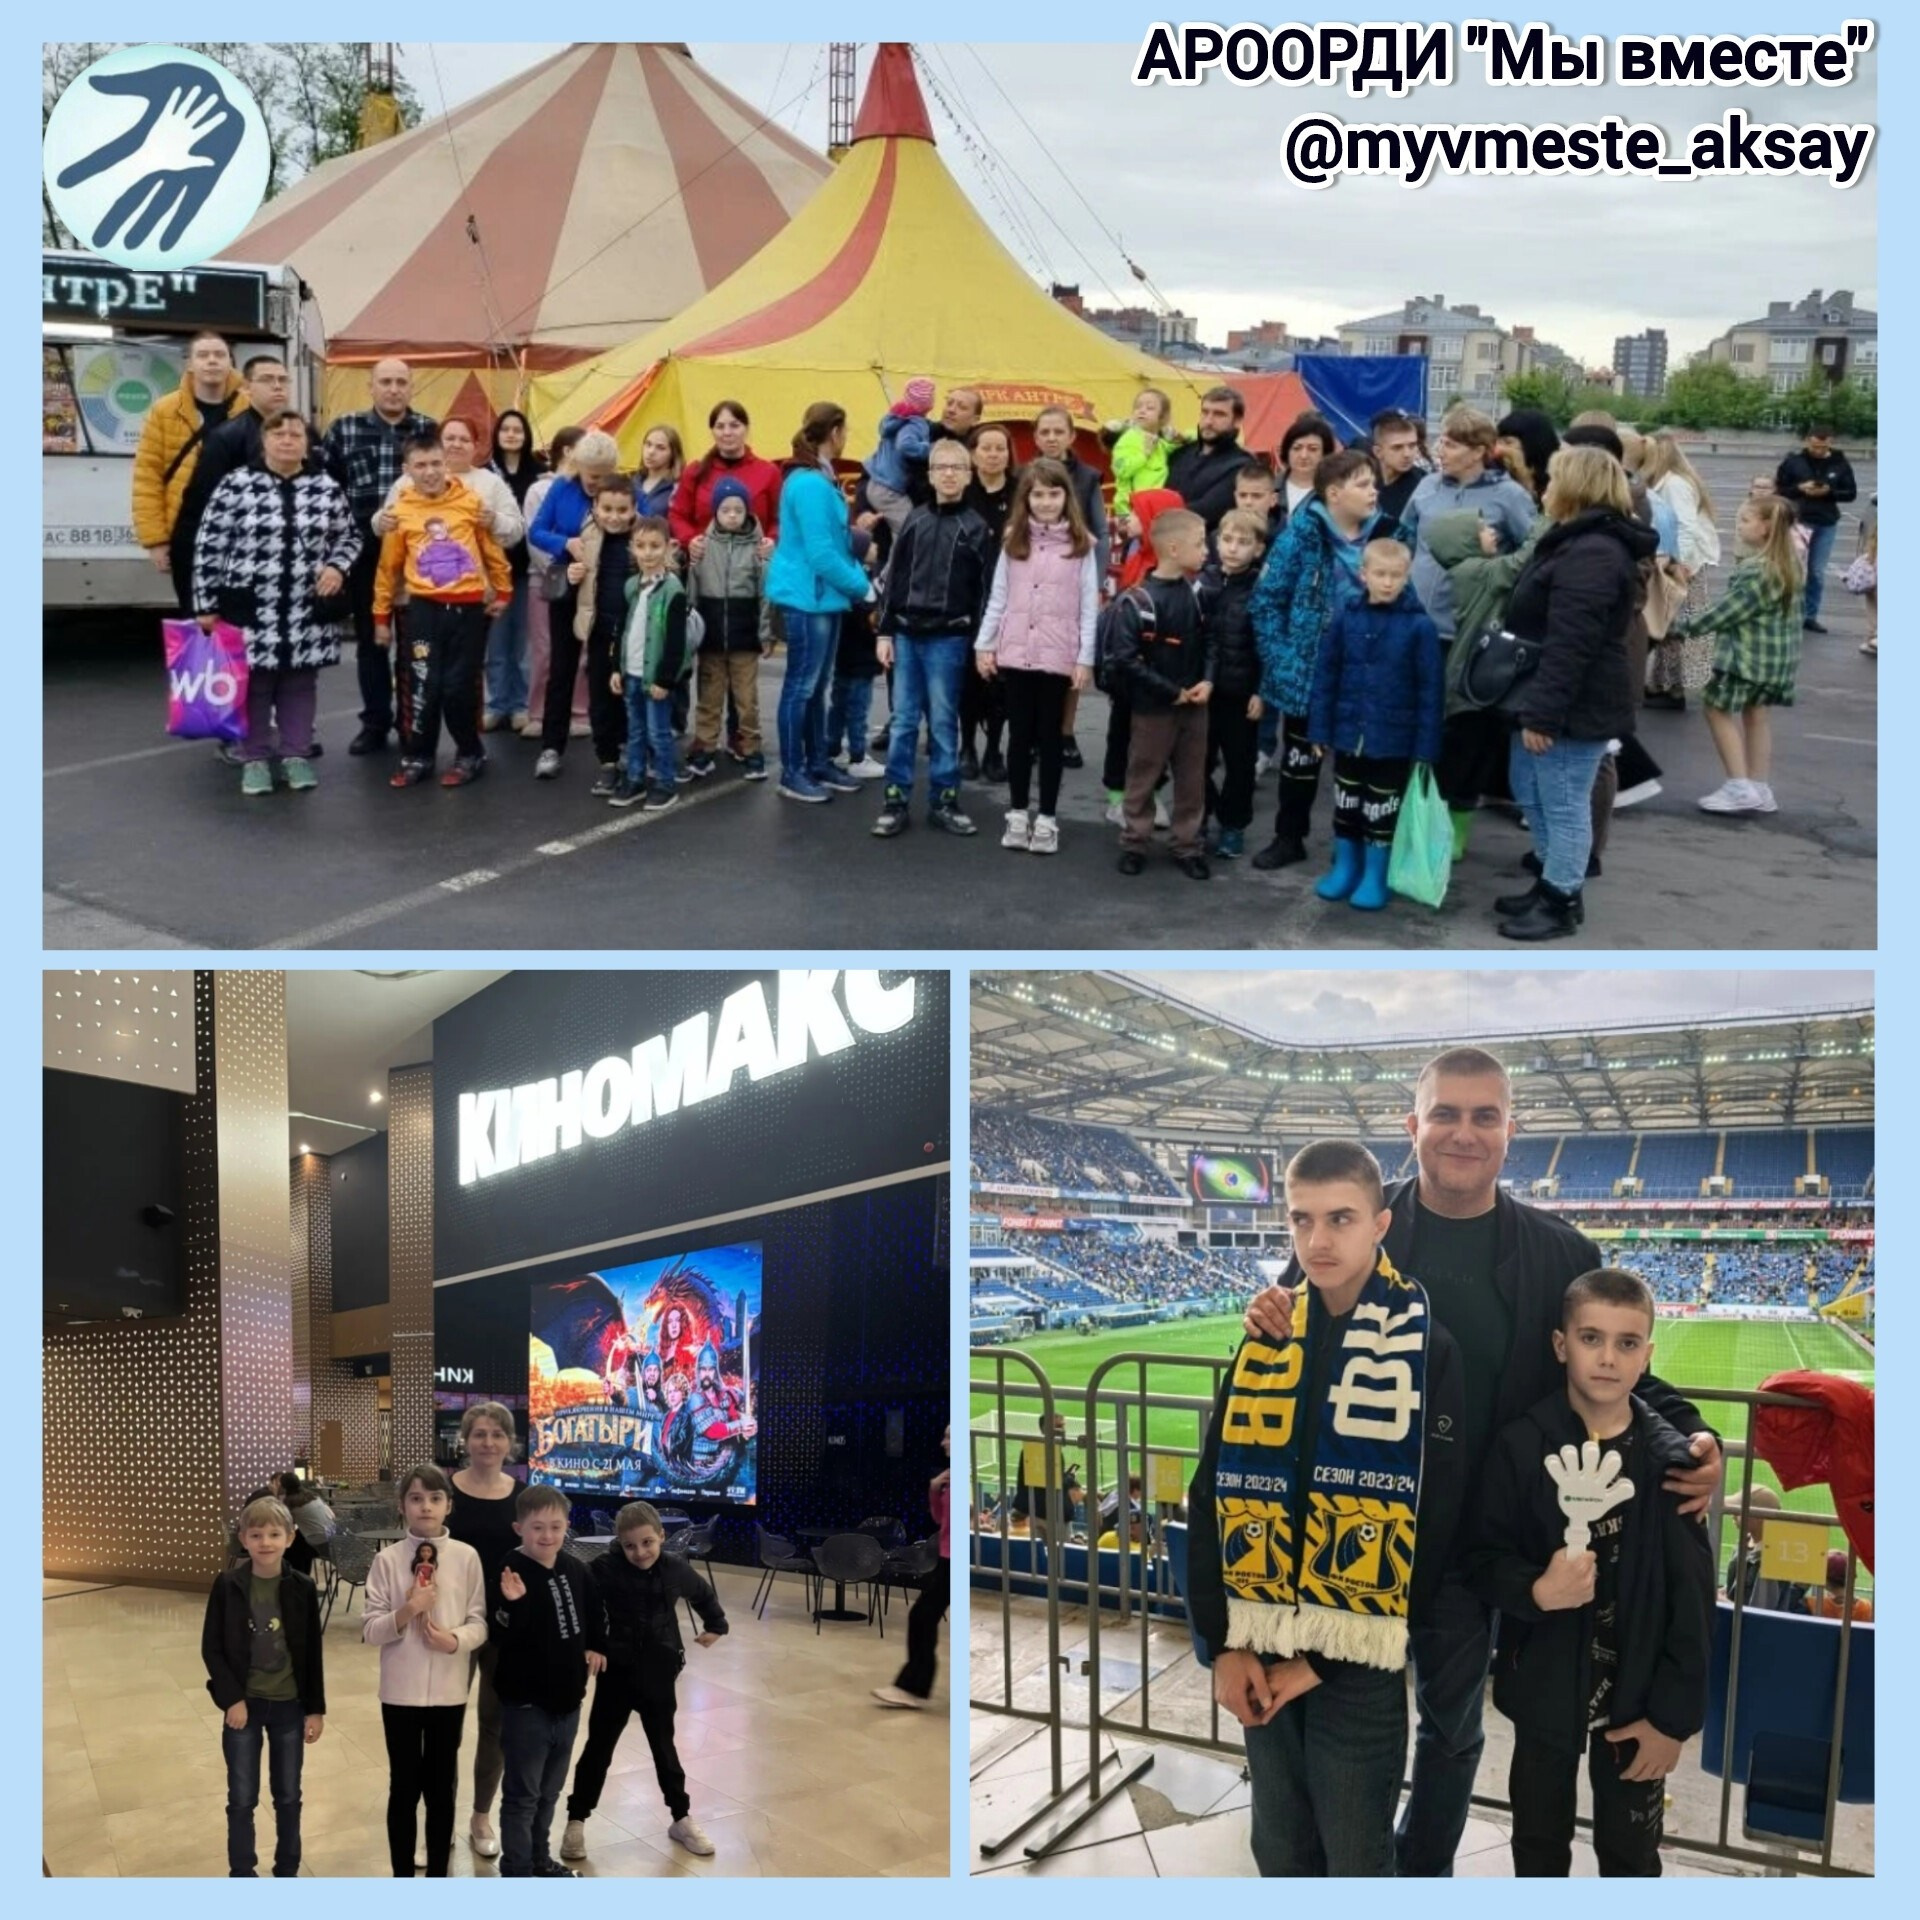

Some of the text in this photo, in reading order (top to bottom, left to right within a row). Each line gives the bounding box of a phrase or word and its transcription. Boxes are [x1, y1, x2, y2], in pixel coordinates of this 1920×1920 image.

[533, 1414, 654, 1457] БОГАТЫРИ
[557, 1457, 590, 1469] КИНО
[592, 1458, 600, 1470] С
[603, 1459, 612, 1470] 21
[615, 1459, 642, 1471] МАЯ
[1245, 1474, 1288, 1492] 2023/24
[1313, 1465, 1415, 1493] СЕЗОН 2023/24
